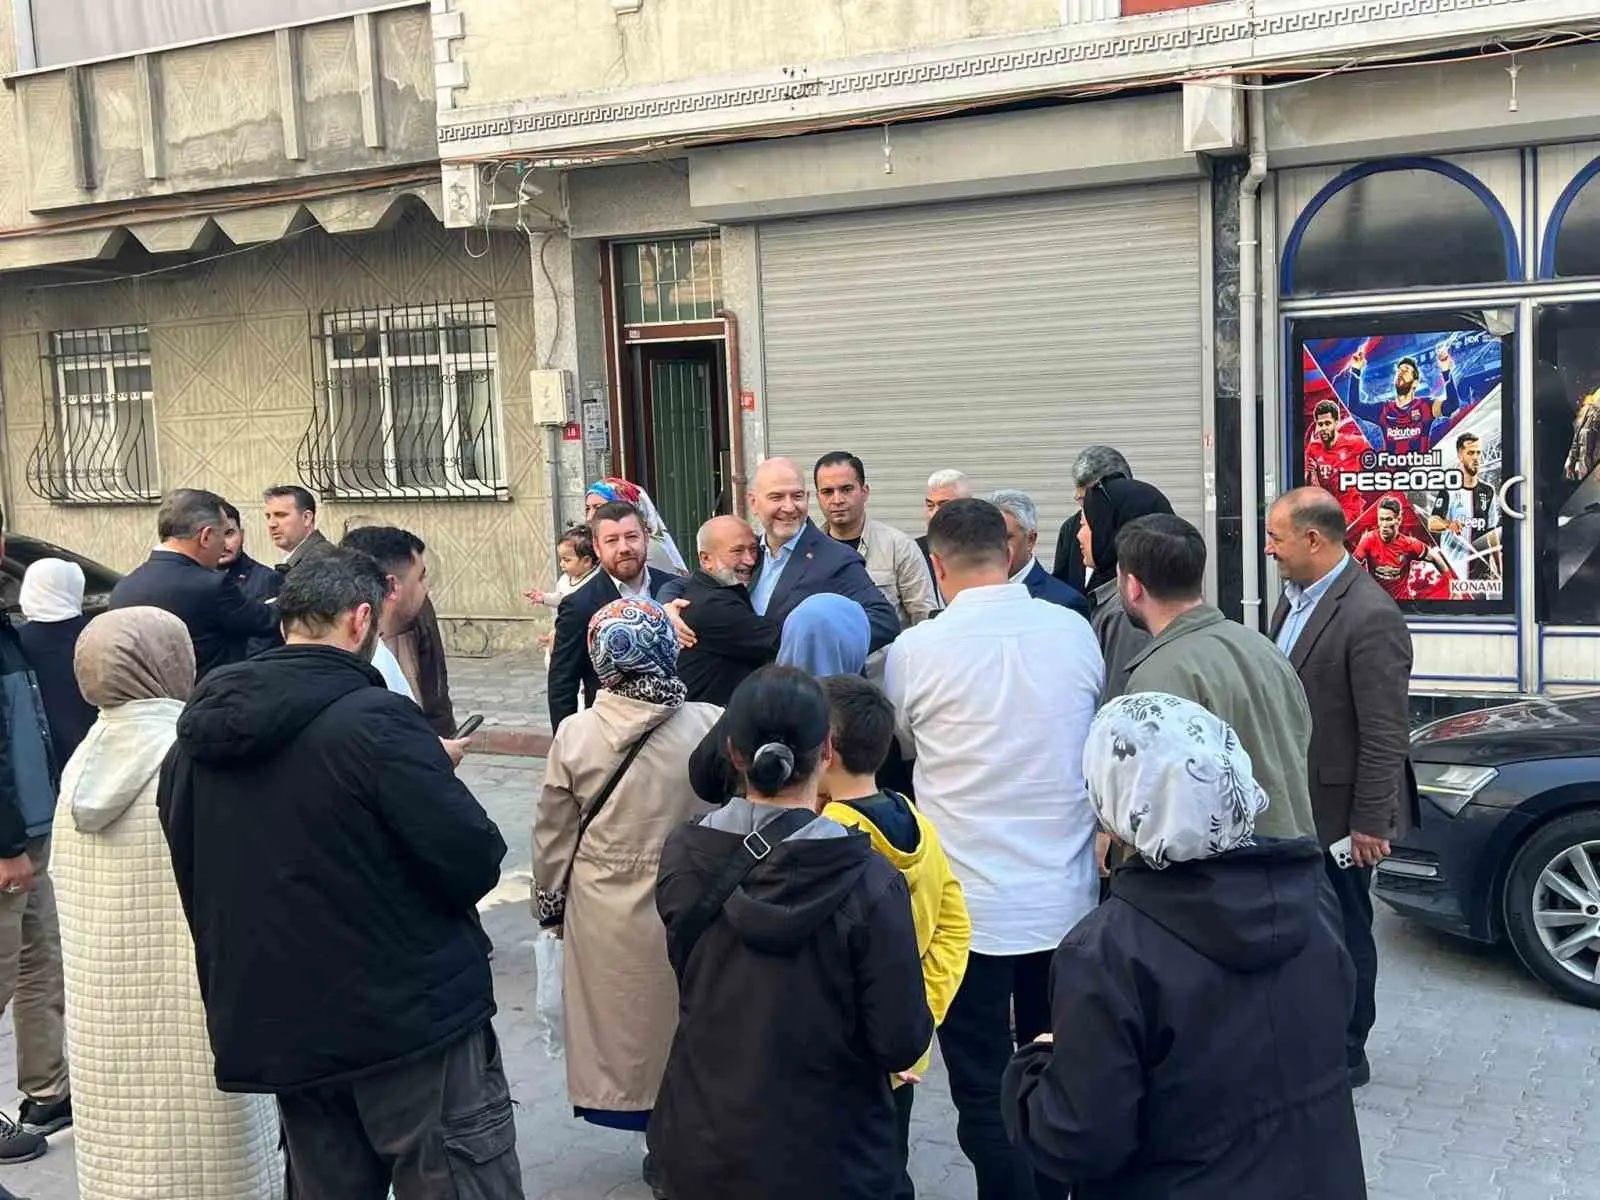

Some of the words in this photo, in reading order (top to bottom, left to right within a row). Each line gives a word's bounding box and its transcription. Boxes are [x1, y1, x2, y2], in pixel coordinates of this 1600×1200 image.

[1387, 427, 1421, 438] Rakuten
[1340, 470, 1463, 491] PES2020
[1451, 581, 1502, 593] KONAMI
